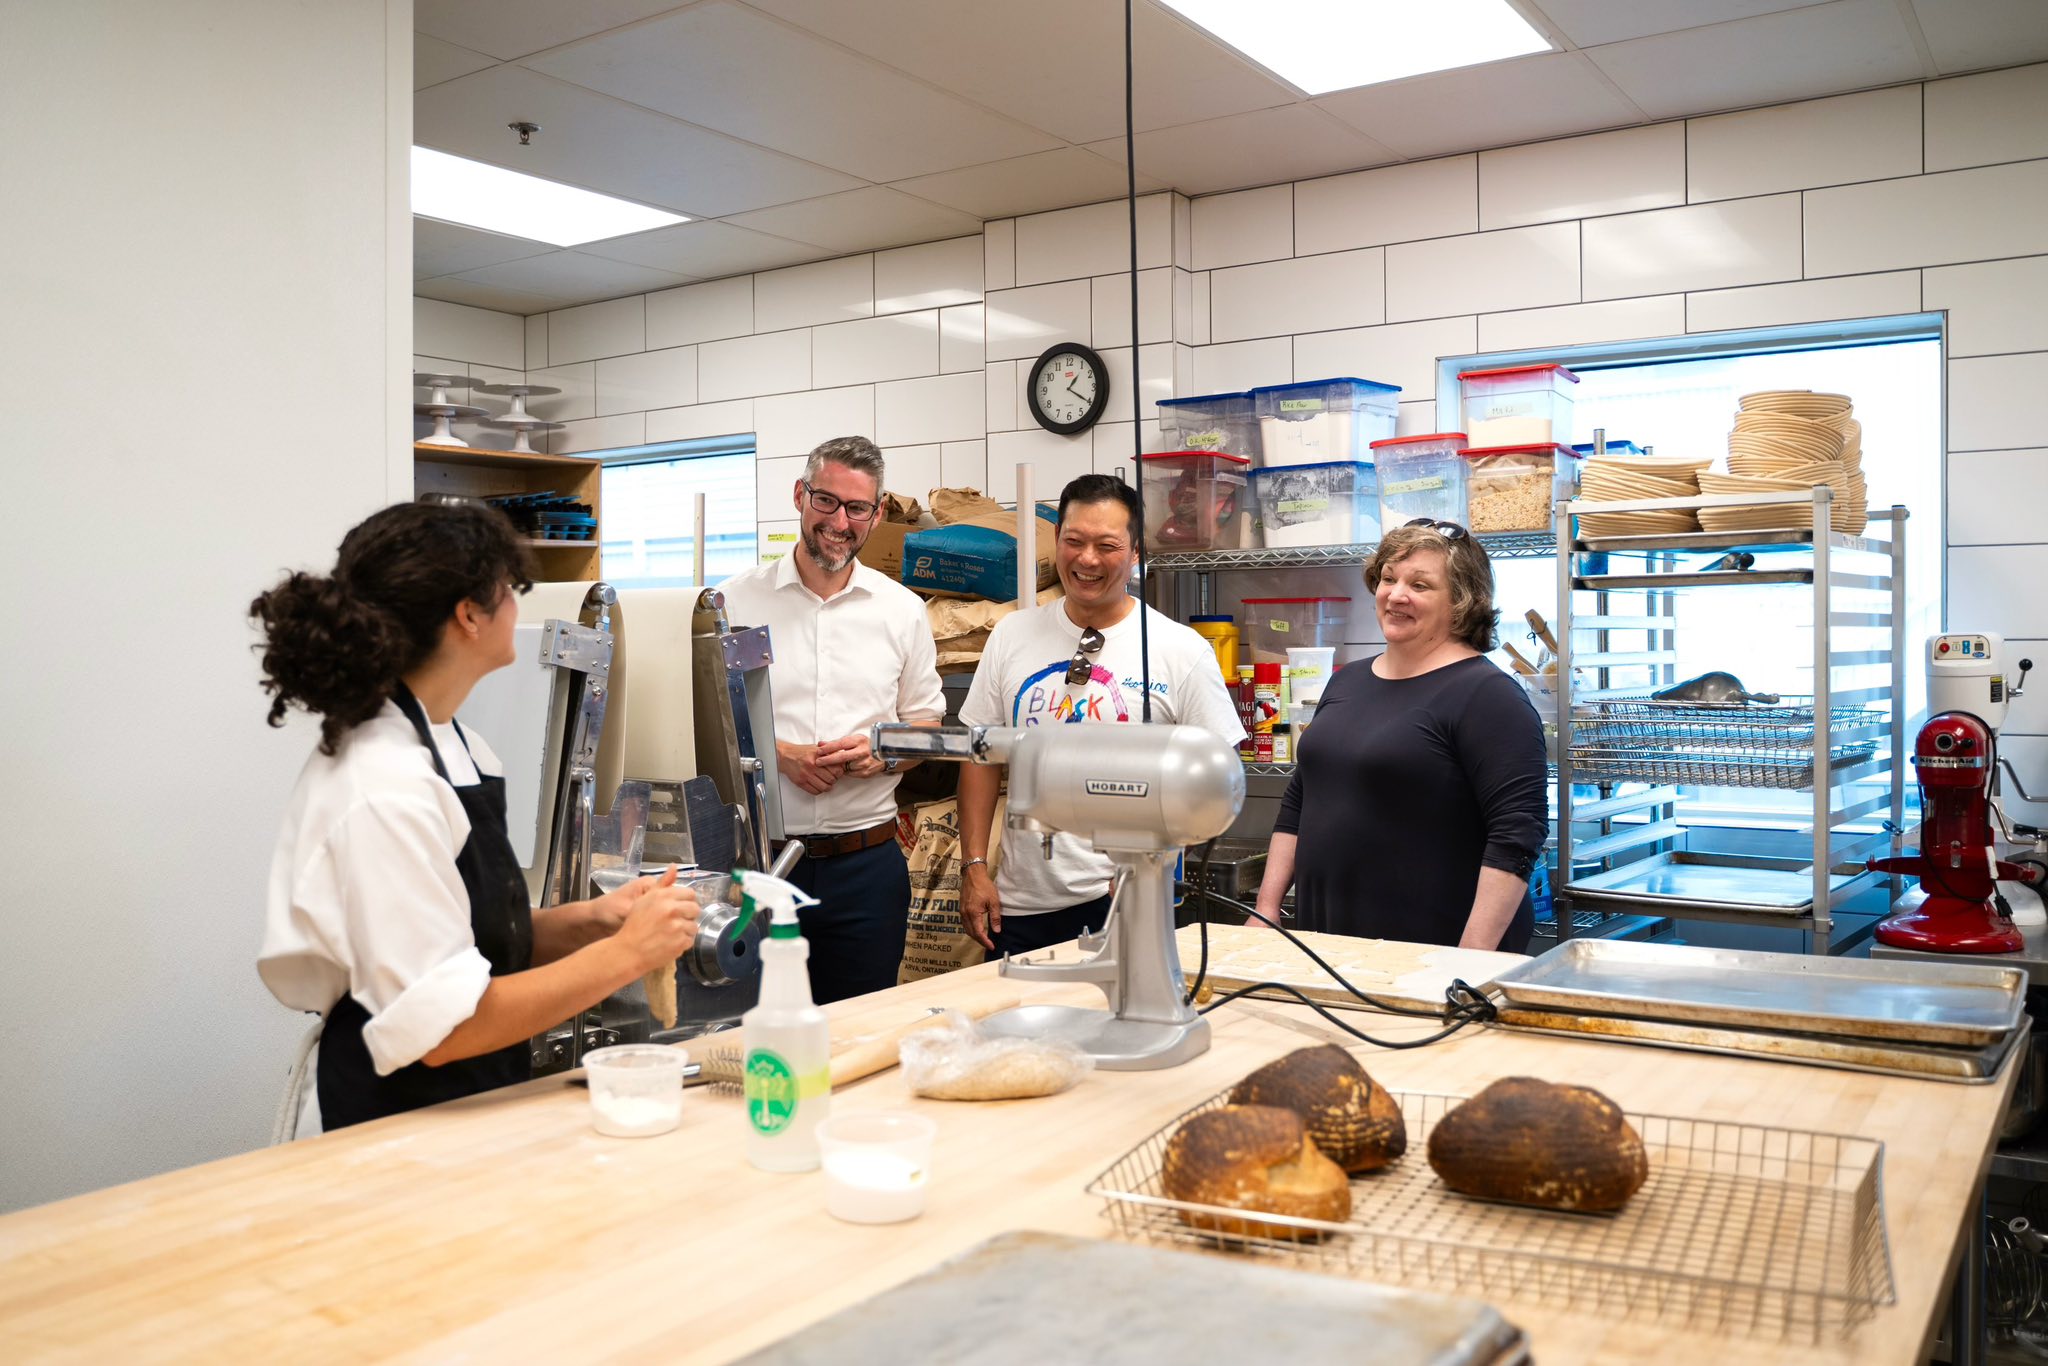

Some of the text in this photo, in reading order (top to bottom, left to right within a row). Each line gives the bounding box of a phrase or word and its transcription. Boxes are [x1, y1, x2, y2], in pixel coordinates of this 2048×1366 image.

[1066, 357, 1074, 366] 12
[1080, 361, 1084, 369] 1
[1055, 362, 1061, 371] 11
[1047, 373, 1055, 382] 10
[1088, 370, 1093, 378] 2
[1042, 386, 1048, 395] 9
[1091, 383, 1096, 392] 3
[1047, 400, 1052, 408] 8
[1055, 409, 1061, 418] 7
[1067, 412, 1072, 420] 6
[1079, 408, 1084, 416] 5
[913, 568, 937, 580] ADM
[1028, 686, 1104, 721] BLACK
[1919, 756, 1975, 764] KitchenAid
[1091, 782, 1143, 793] HOBART
[923, 941, 952, 953] PACKED
[908, 956, 928, 965] FLOUR
[929, 959, 948, 967] MILLS
